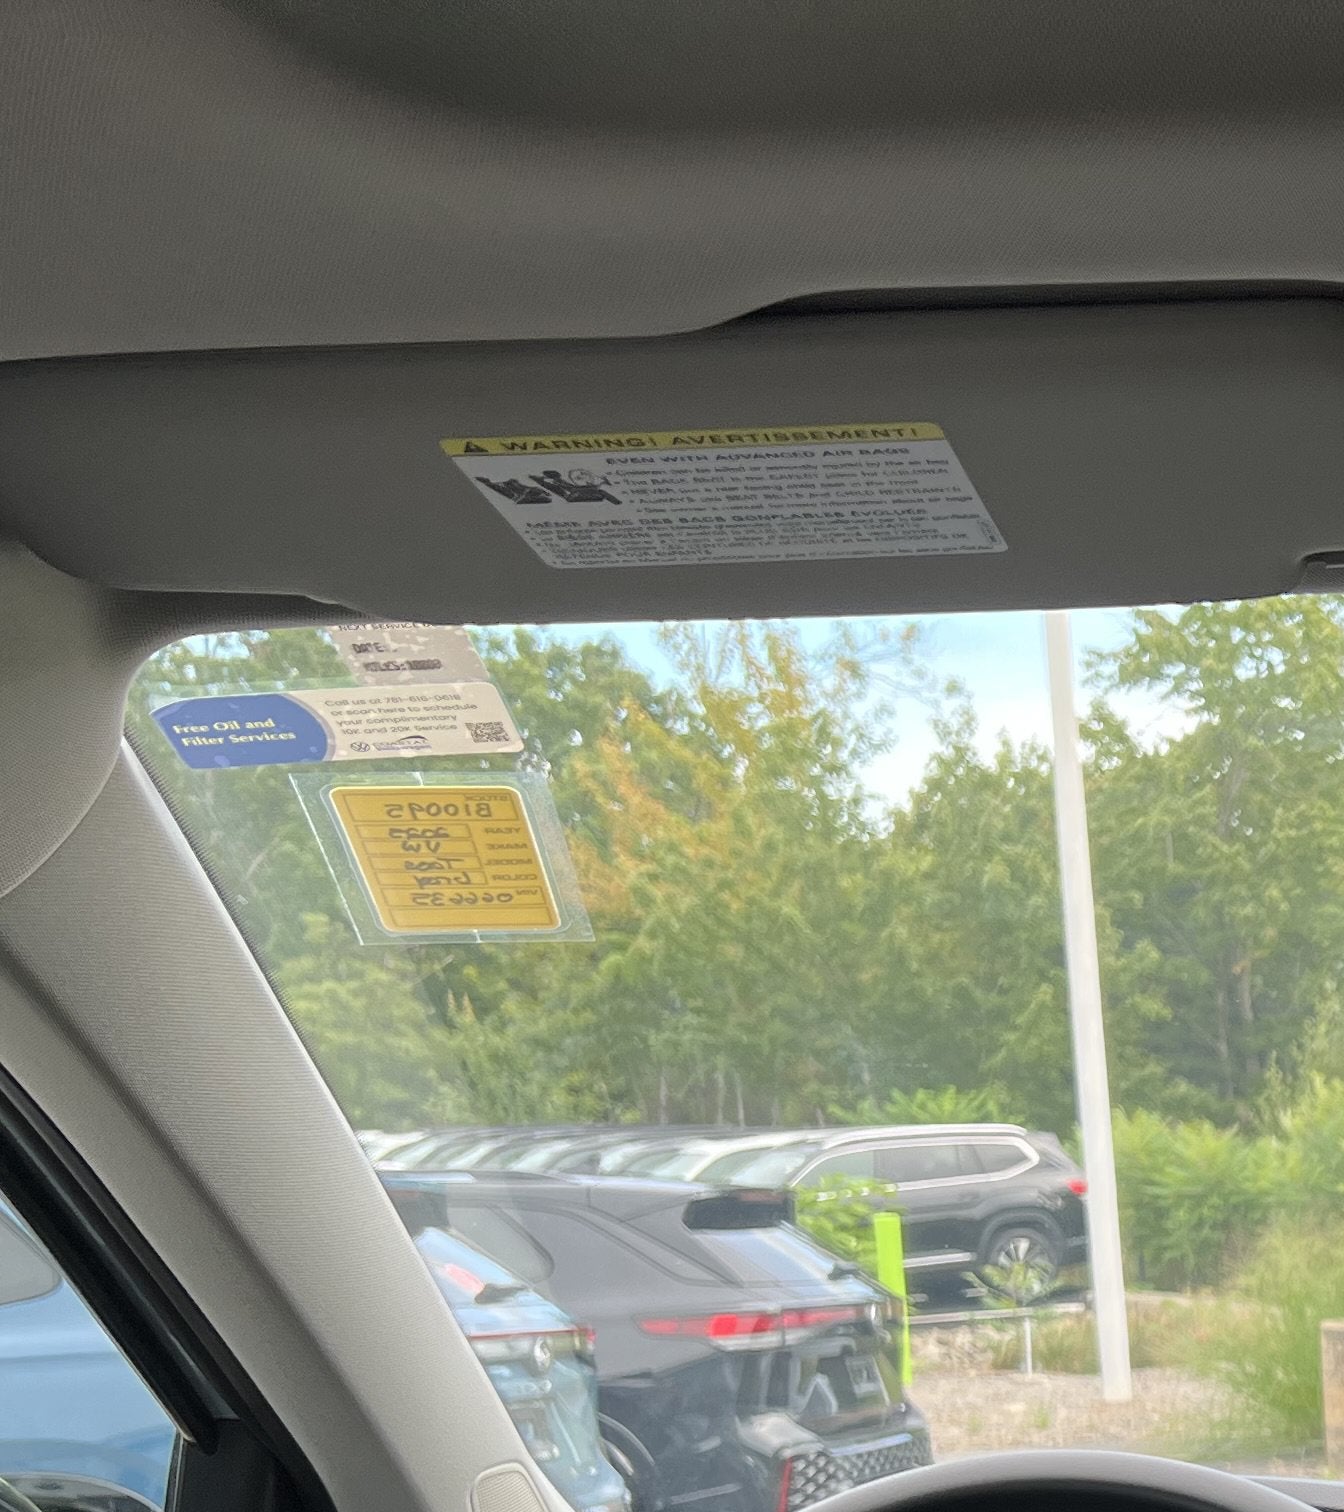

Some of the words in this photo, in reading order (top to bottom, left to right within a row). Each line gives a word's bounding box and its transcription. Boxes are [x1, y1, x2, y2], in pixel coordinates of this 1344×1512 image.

[502, 436, 657, 451] WARNING!
[672, 428, 919, 446] AVERTISSEMENT!
[660, 455, 708, 463] WITH
[822, 449, 854, 457] AIR
[172, 725, 209, 734] Free
[213, 720, 241, 731] Oil
[245, 718, 275, 729] and
[181, 736, 225, 747] Filter
[228, 731, 297, 744] Services
